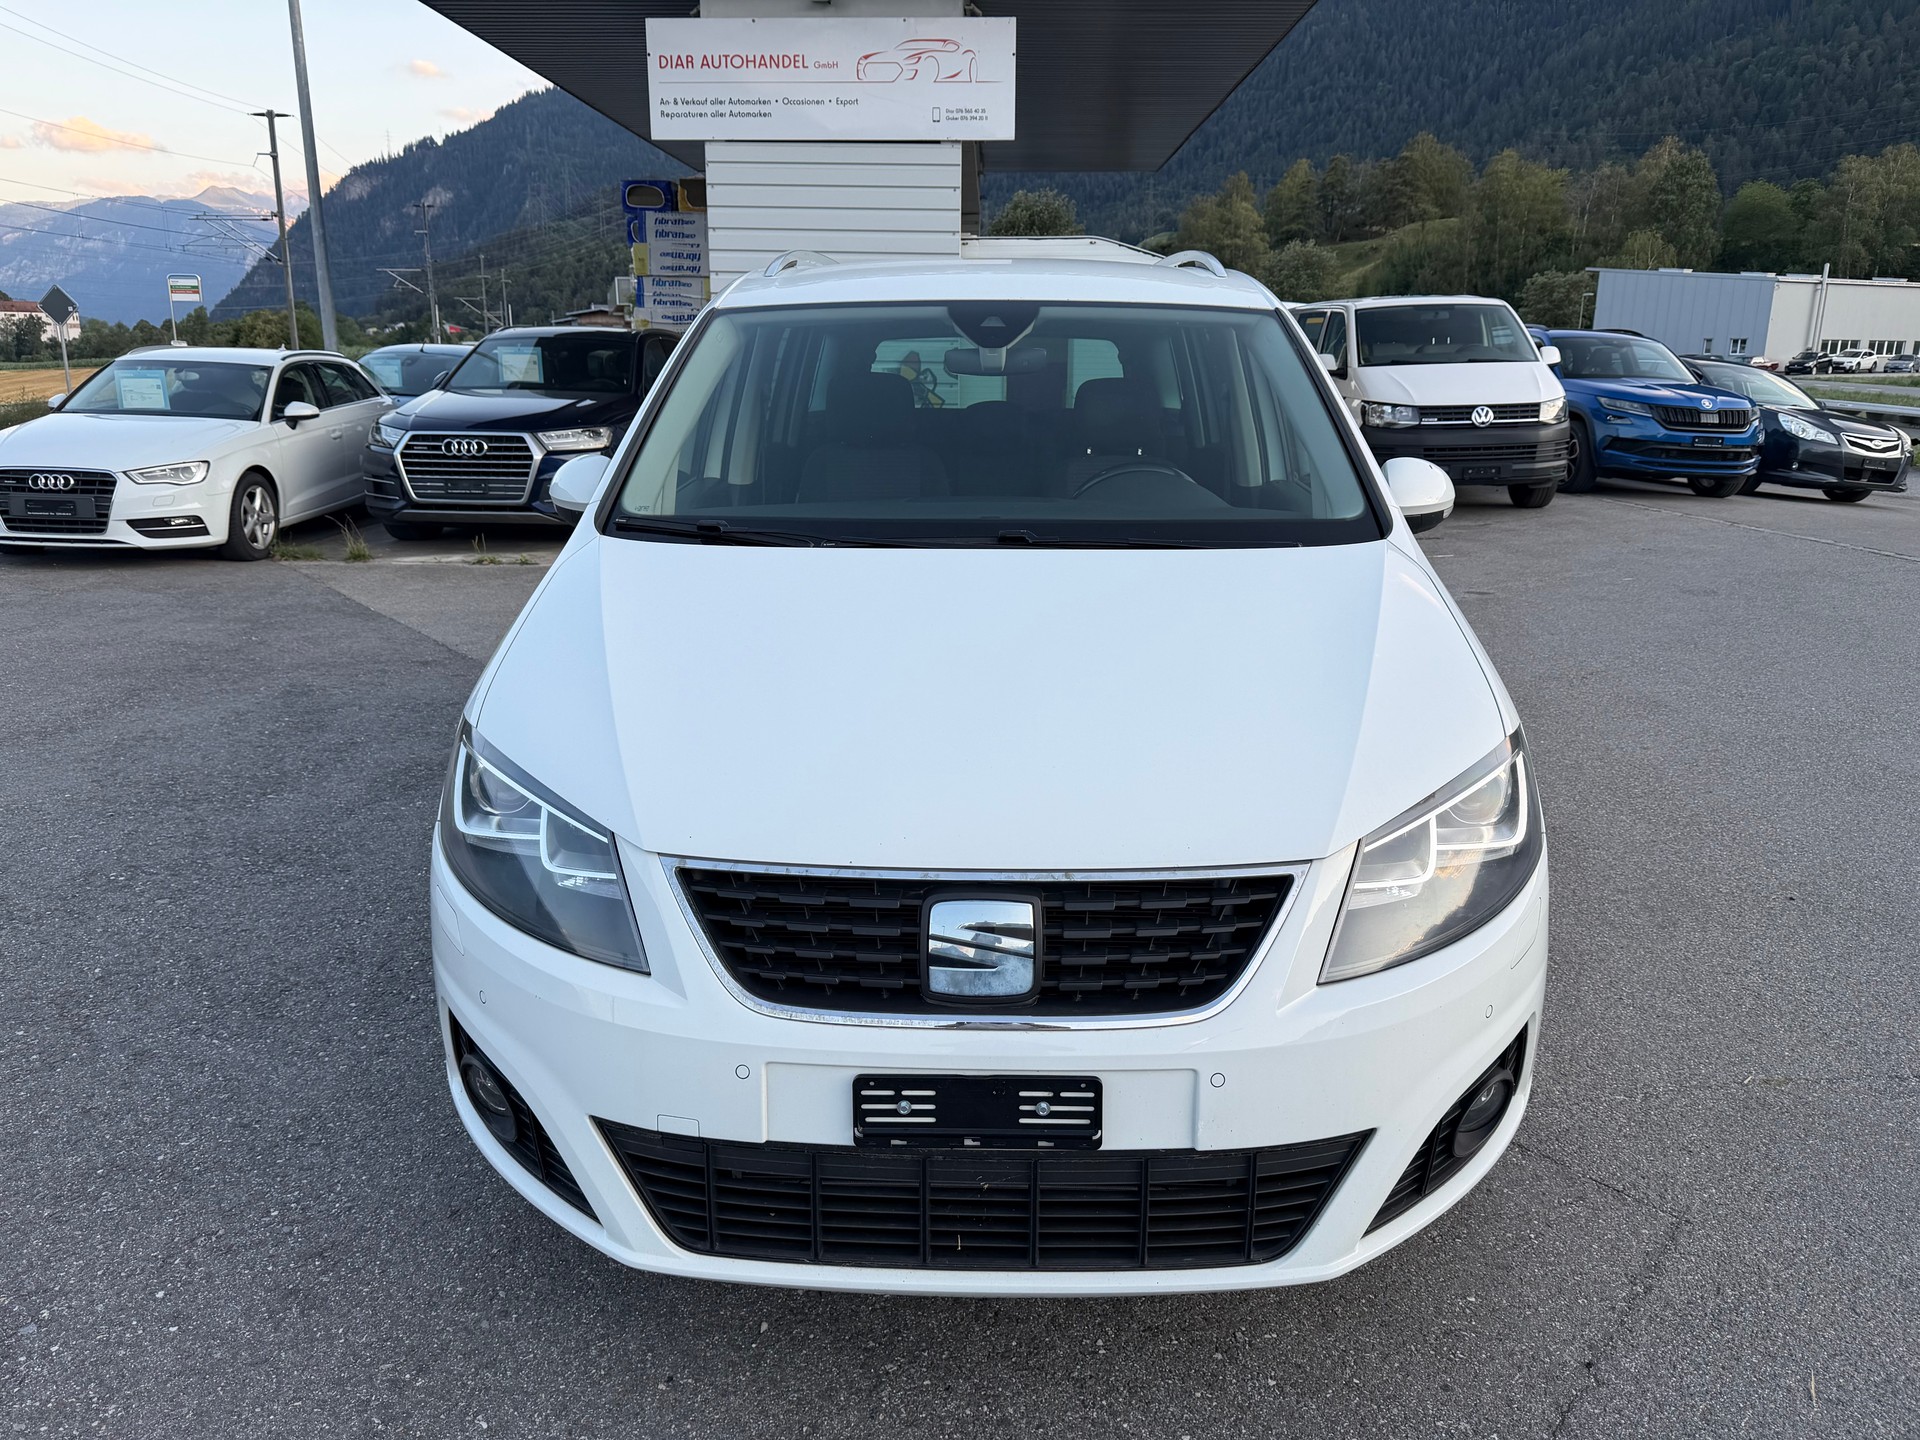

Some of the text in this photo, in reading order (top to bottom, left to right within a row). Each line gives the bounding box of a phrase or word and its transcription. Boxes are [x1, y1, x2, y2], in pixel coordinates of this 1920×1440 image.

[658, 54, 839, 69] DIAR AUTOHANDEL GmbH
[659, 97, 859, 107] An- & Verkauf aller Automarken Occasionen Export
[660, 110, 772, 120] Reparaturen aller Automarken
